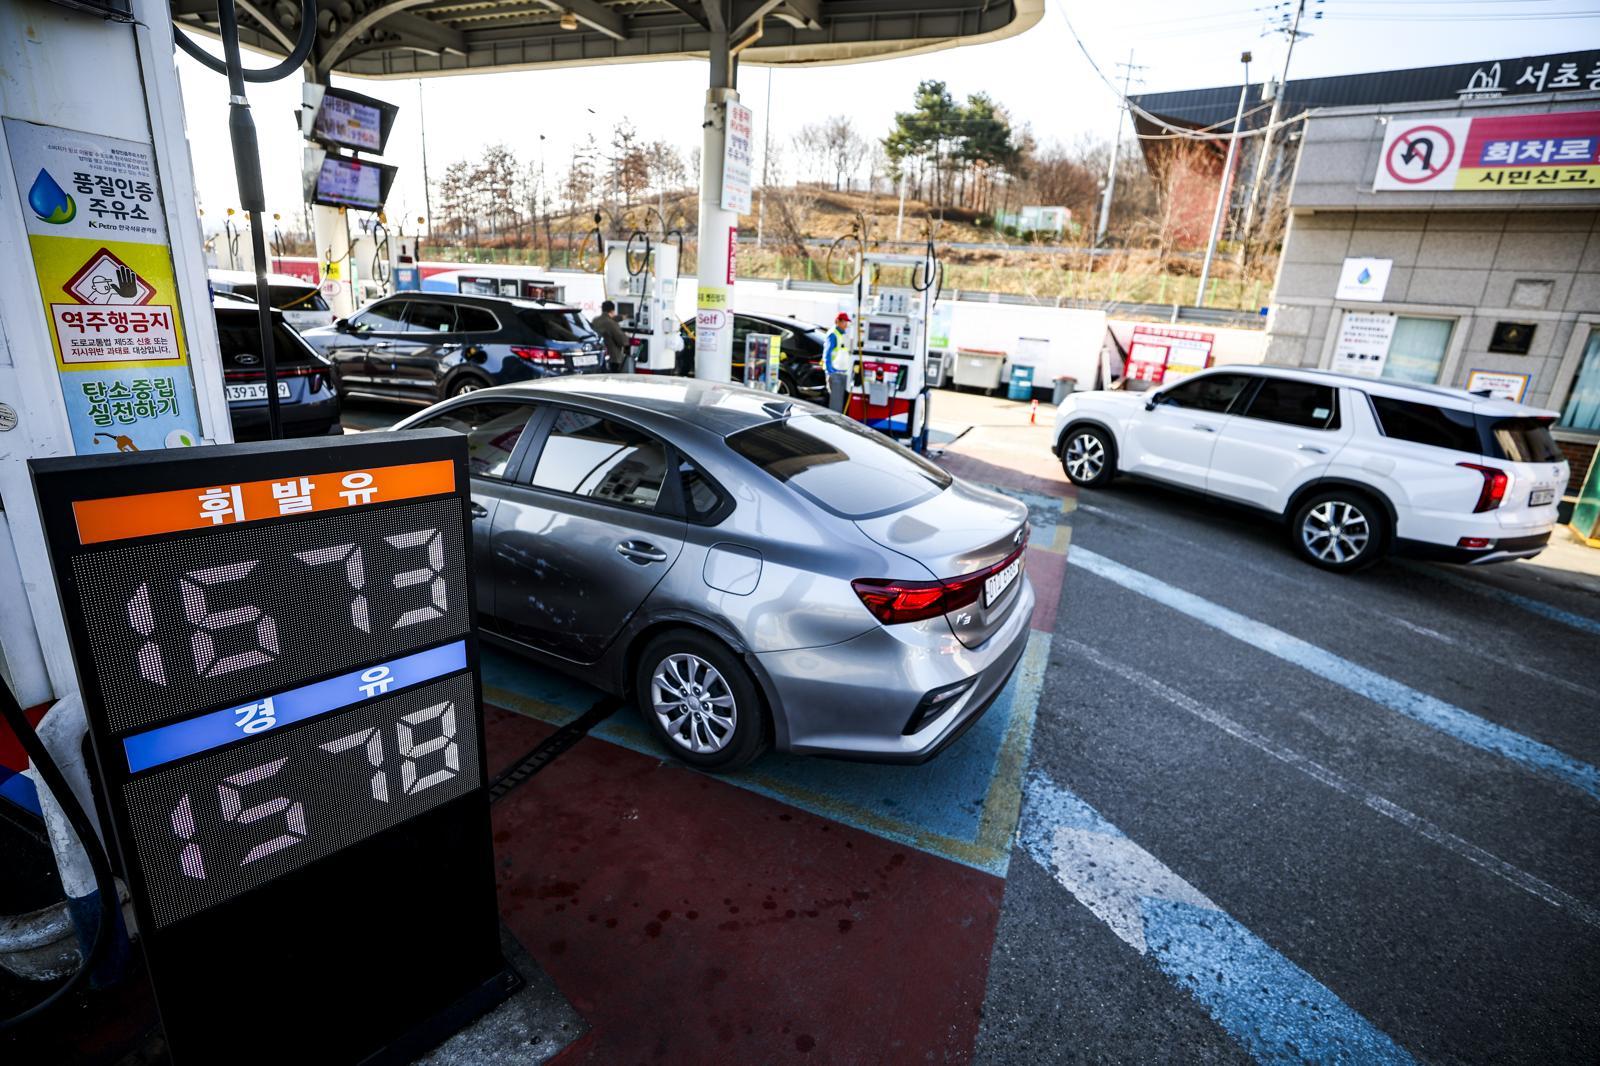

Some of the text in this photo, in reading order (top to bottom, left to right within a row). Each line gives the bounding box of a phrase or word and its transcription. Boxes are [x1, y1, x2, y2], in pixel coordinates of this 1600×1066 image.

[1483, 139, 1591, 164] 회차로
[73, 172, 154, 202] 품질인증
[89, 198, 150, 220] 주유소
[61, 311, 169, 334] 역주행금지
[71, 338, 111, 347] 도로교통법
[137, 337, 151, 345] 신호
[153, 336, 168, 345] 또는
[71, 347, 104, 356] 지시위반
[107, 347, 130, 355] 과태료
[82, 377, 175, 404] 탄소중립
[88, 398, 179, 426] 실천하기
[126, 528, 448, 686] 1673
[169, 700, 460, 880] 1578
